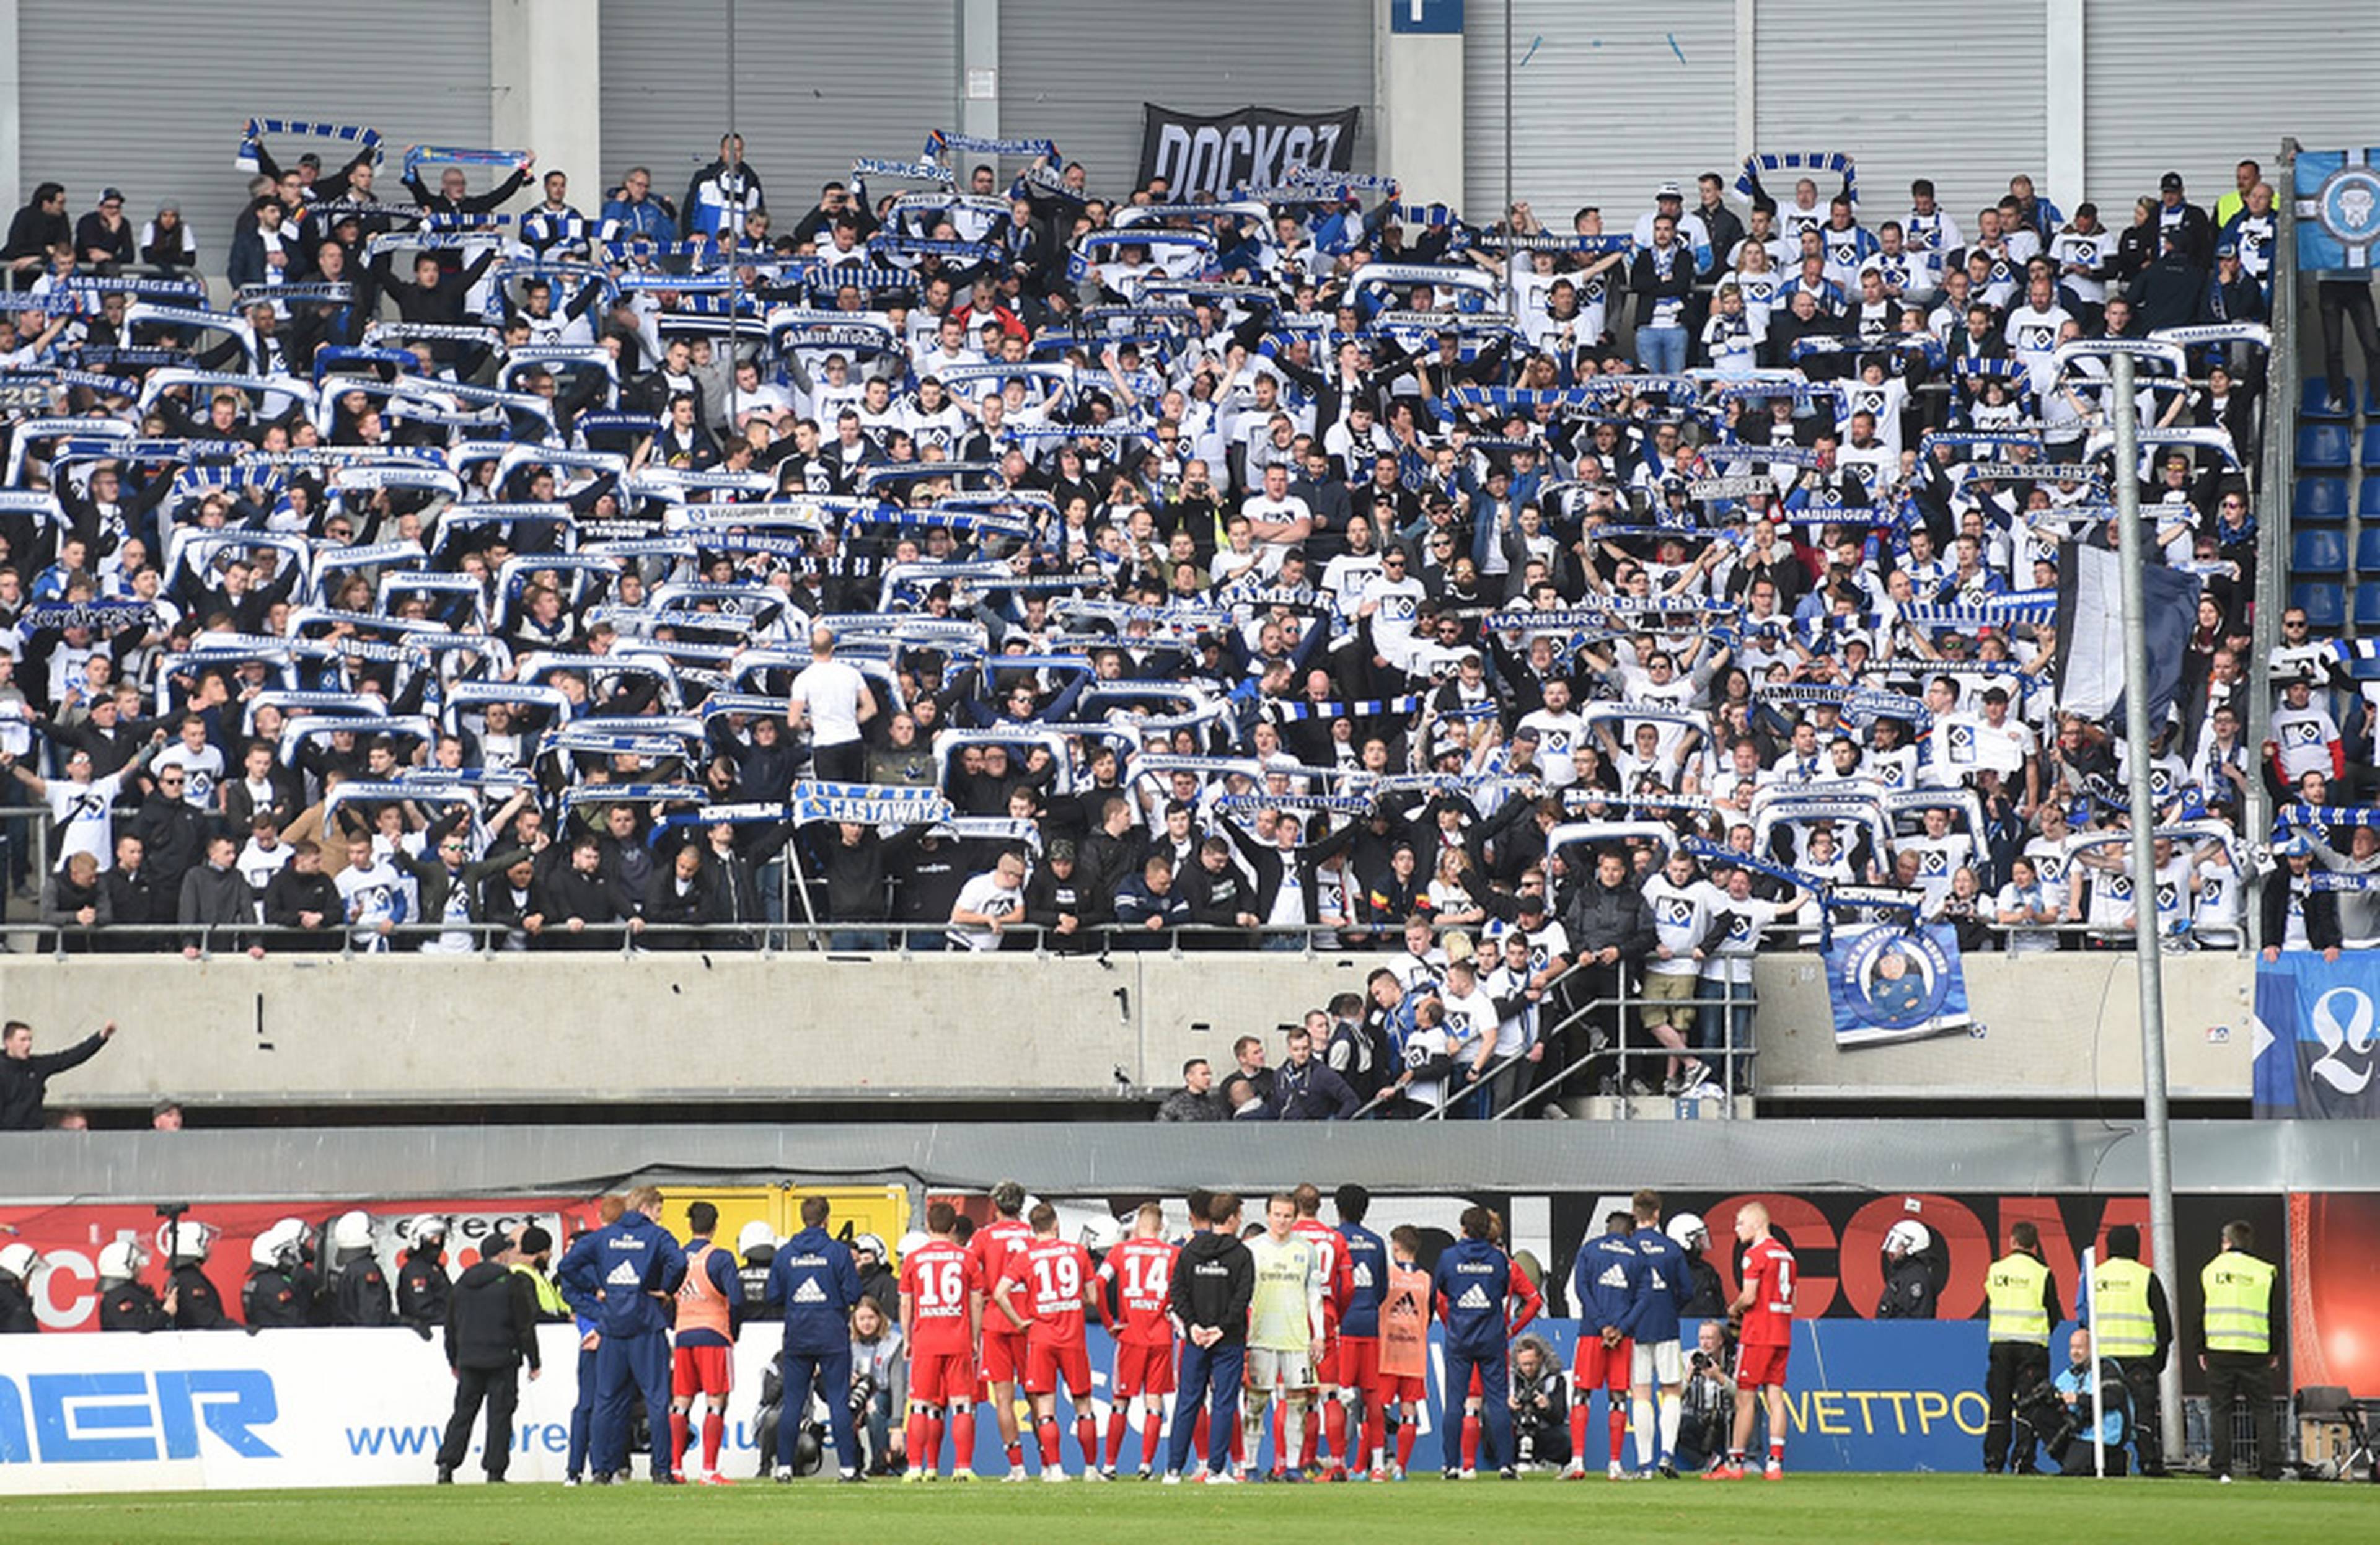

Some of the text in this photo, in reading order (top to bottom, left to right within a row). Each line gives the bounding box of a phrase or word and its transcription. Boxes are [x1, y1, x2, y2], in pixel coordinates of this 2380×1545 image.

[68, 276, 184, 294] HAMBURGER
[1620, 597, 1657, 608] DER
[1664, 595, 1708, 608] HSV
[1488, 612, 1606, 627] HAMBURG
[831, 799, 944, 825] CASTAWAYS
[918, 1261, 963, 1306] 16
[1034, 1256, 1080, 1303] 19
[1124, 1254, 1168, 1300] 14
